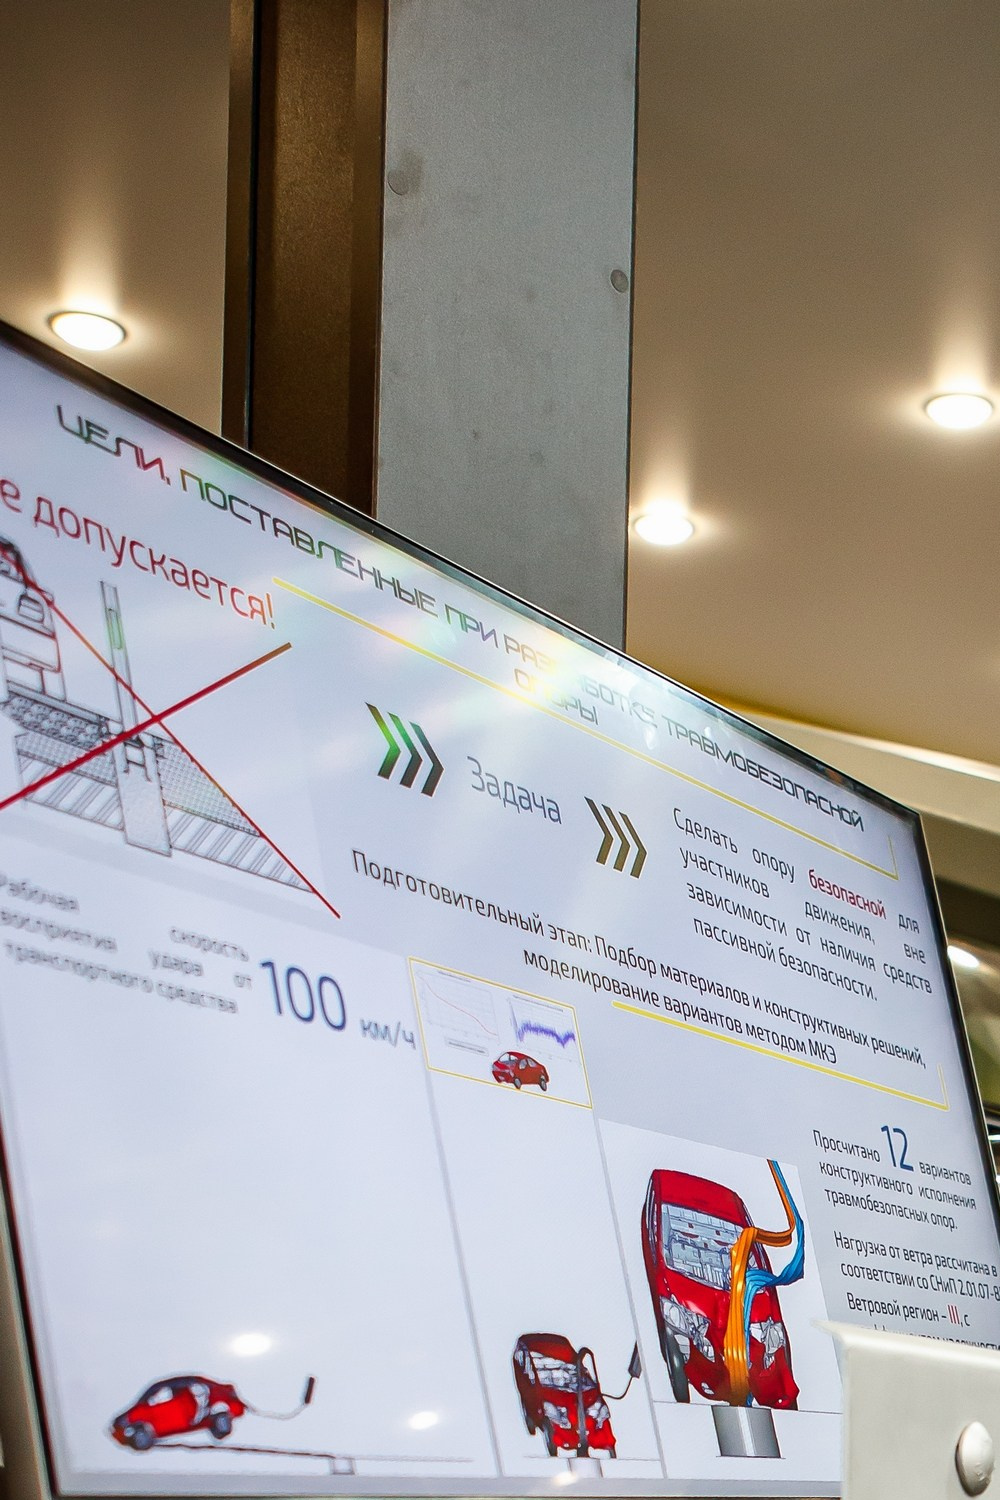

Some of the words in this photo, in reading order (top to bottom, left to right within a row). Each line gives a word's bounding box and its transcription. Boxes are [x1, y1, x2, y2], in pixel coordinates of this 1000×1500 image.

[33, 495, 277, 630] допускается!
[179, 468, 438, 616] ПОСТАВЛЕННЫЕ
[445, 603, 499, 649] ПРИ
[503, 633, 658, 729] РАЗБОТКЕ
[661, 714, 865, 832] ТРАВМОБЕЗОПАСНОЙ
[513, 668, 599, 726] ОРЫ
[466, 756, 563, 825] Задача
[673, 807, 738, 854] Сделать
[752, 848, 795, 883] опору
[808, 868, 887, 920] безопасной
[898, 913, 920, 934] для
[680, 847, 770, 899] участников
[804, 901, 876, 946] движения,
[904, 943, 926, 965] вне
[352, 848, 545, 937] Подготовительный
[548, 923, 593, 953] этап:
[594, 935, 657, 978] Подбор
[660, 963, 750, 1007] материалов
[752, 995, 762, 1011] и
[764, 999, 869, 1049] конструктивных
[871, 1035, 927, 1069] решений,
[686, 882, 787, 937] зависимости
[795, 928, 811, 946] от
[820, 936, 876, 972] наличия
[883, 962, 933, 994] средств
[693, 917, 776, 964] пассивной
[778, 946, 878, 1002] безопасности.
[260, 959, 347, 1032] 100
[360, 1016, 416, 1050] км/ч
[523, 949, 660, 1008] моделирование
[663, 994, 743, 1035] вариантов
[746, 1023, 807, 1055] методом
[808, 1037, 837, 1064] МКЭ
[812, 1129, 881, 1163] Просчитано
[881, 1124, 914, 1172] 12
[919, 1161, 972, 1186] вариантов
[819, 1161, 914, 1196] конструктивного
[918, 1185, 977, 1210] исполнения
[824, 1188, 930, 1225] травмобезопасных
[930, 1212, 958, 1232] опор.
[833, 1230, 887, 1258] Нагрузка
[888, 1245, 901, 1260] от
[902, 1249, 934, 1271] ветра
[934, 1254, 991, 1277] рассчитана
[991, 1264, 998, 1278] в
[840, 1261, 915, 1288] соответствии
[916, 1275, 929, 1290] со
[930, 1274, 958, 1294] СНиП
[846, 1291, 902, 1318] Ветровой
[902, 1303, 940, 1323] регион
[964, 1313, 971, 1327] с
